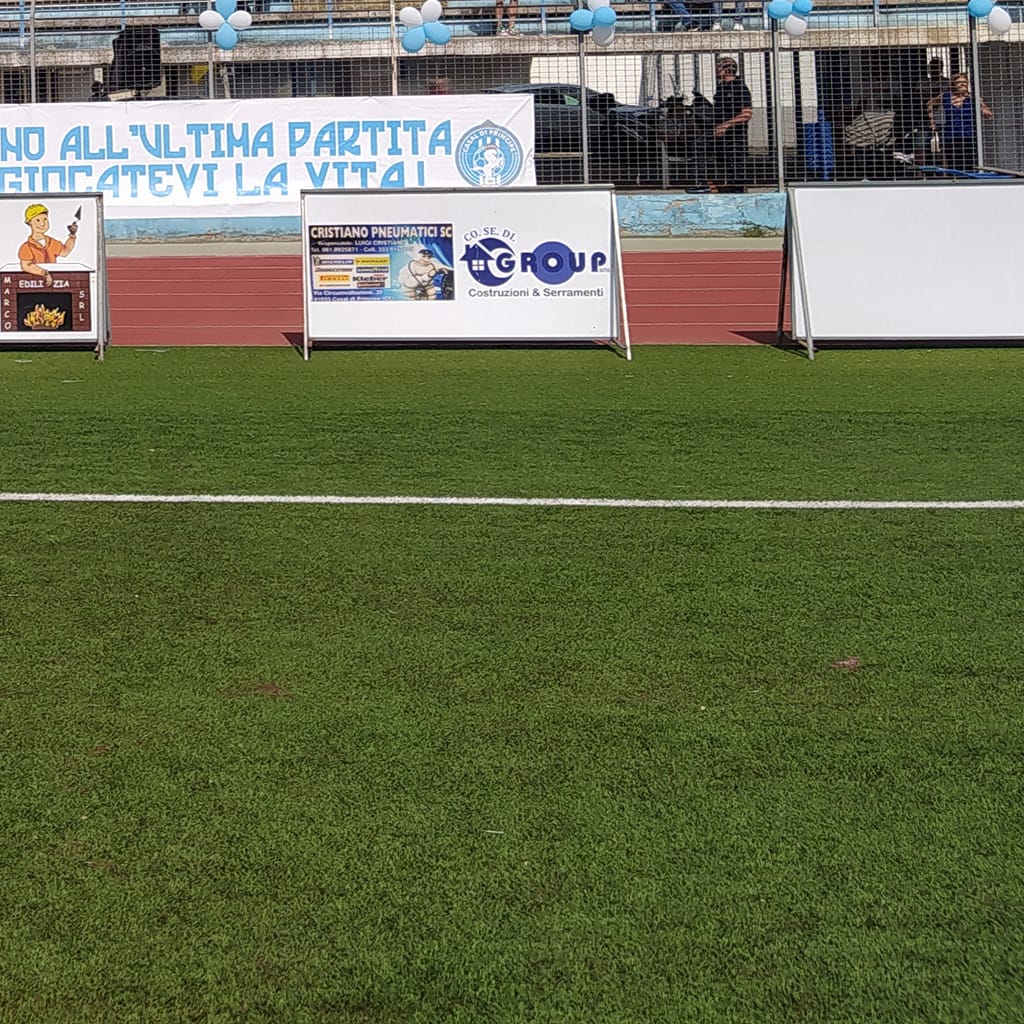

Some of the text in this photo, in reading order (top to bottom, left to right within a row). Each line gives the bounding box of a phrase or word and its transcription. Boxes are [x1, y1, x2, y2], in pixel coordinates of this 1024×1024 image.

[60, 123, 274, 161] ALL'ULTIMA
[288, 120, 452, 158] PARTITA
[235, 163, 288, 196] LA
[310, 226, 369, 239] CRISTIANO
[371, 226, 438, 238] PNEUMATICI
[463, 226, 517, 242] CO. SE. DI.
[495, 251, 607, 274] GROUP
[3, 276, 12, 330] MARCO
[468, 287, 604, 298] Costruzioni & Serramenti
